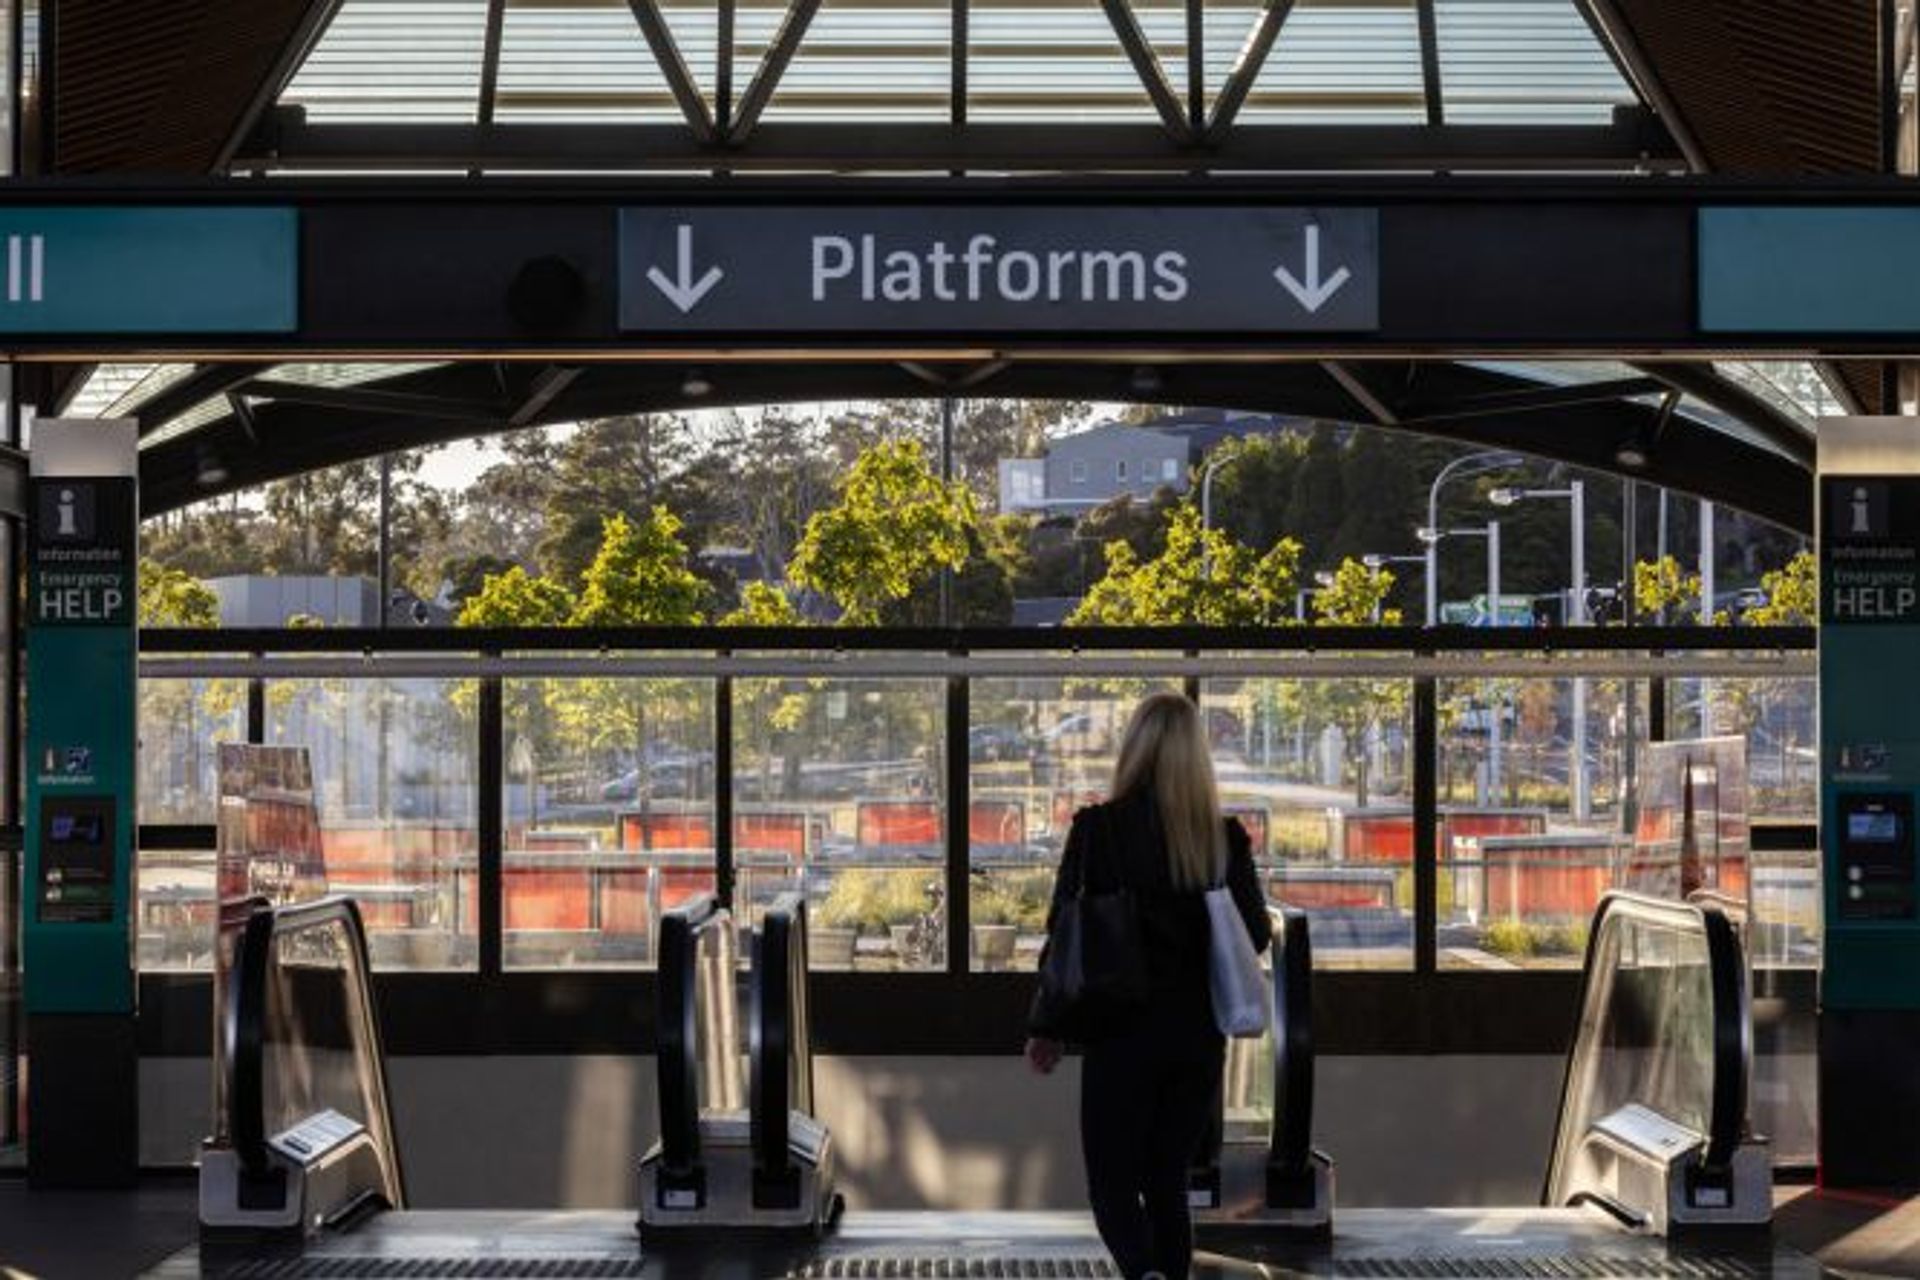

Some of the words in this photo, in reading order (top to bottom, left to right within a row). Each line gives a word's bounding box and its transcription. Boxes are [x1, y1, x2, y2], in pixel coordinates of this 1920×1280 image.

[812, 234, 1189, 301] Platforms
[41, 571, 121, 588] Emergency
[41, 588, 122, 619] HELP
[1833, 587, 1916, 617] HELP
